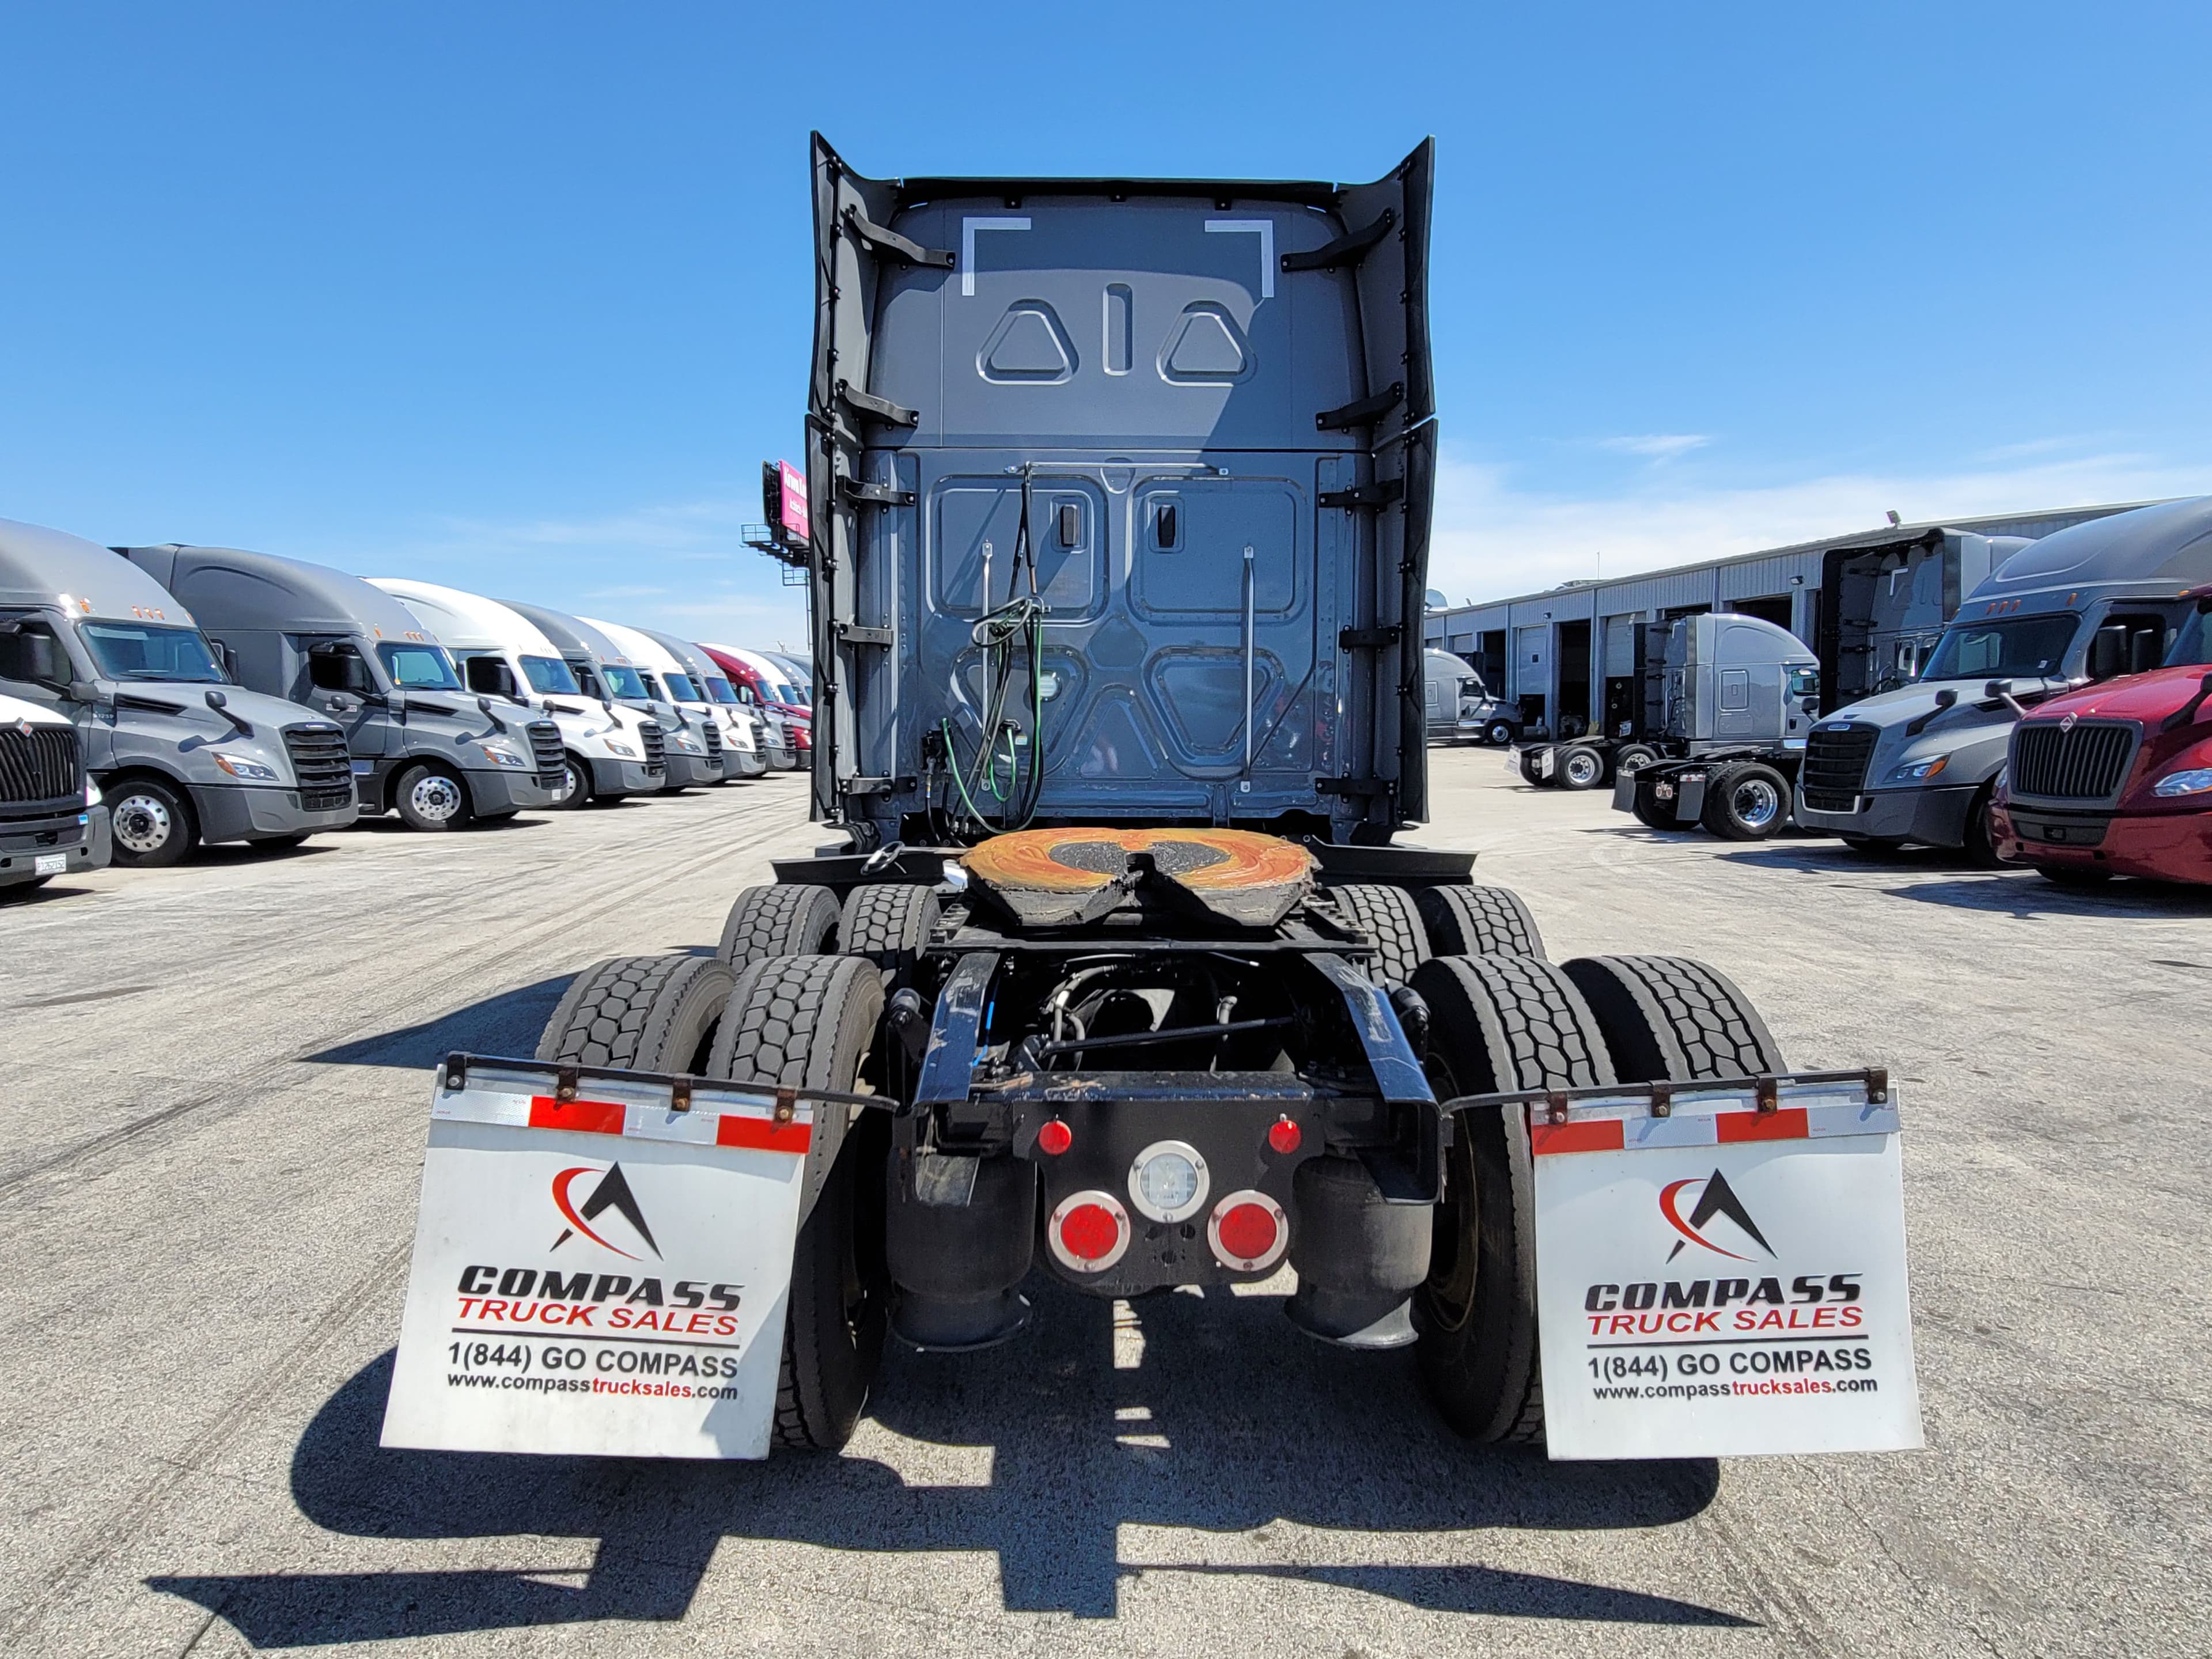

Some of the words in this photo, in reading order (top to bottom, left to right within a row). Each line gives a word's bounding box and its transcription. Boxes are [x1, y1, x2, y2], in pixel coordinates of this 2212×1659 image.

[457, 1265, 745, 1311] COMPASS
[1585, 1273, 1863, 1312] COMPASS
[459, 1297, 599, 1327] TRUCK
[607, 1308, 738, 1336] SALES
[1588, 1311, 1722, 1335] TRUCK
[1733, 1306, 1863, 1331] SALES
[449, 1342, 532, 1374] 1(844)
[541, 1346, 586, 1370] GO
[596, 1350, 738, 1378] COMPASS
[1588, 1354, 1668, 1384] 1(844)
[1677, 1353, 1721, 1376] GO
[1729, 1348, 1872, 1374] COMPASS
[448, 1373, 738, 1400] www.compasstrucksales.com
[1593, 1378, 1878, 1400] www.compasstrucksales.com
